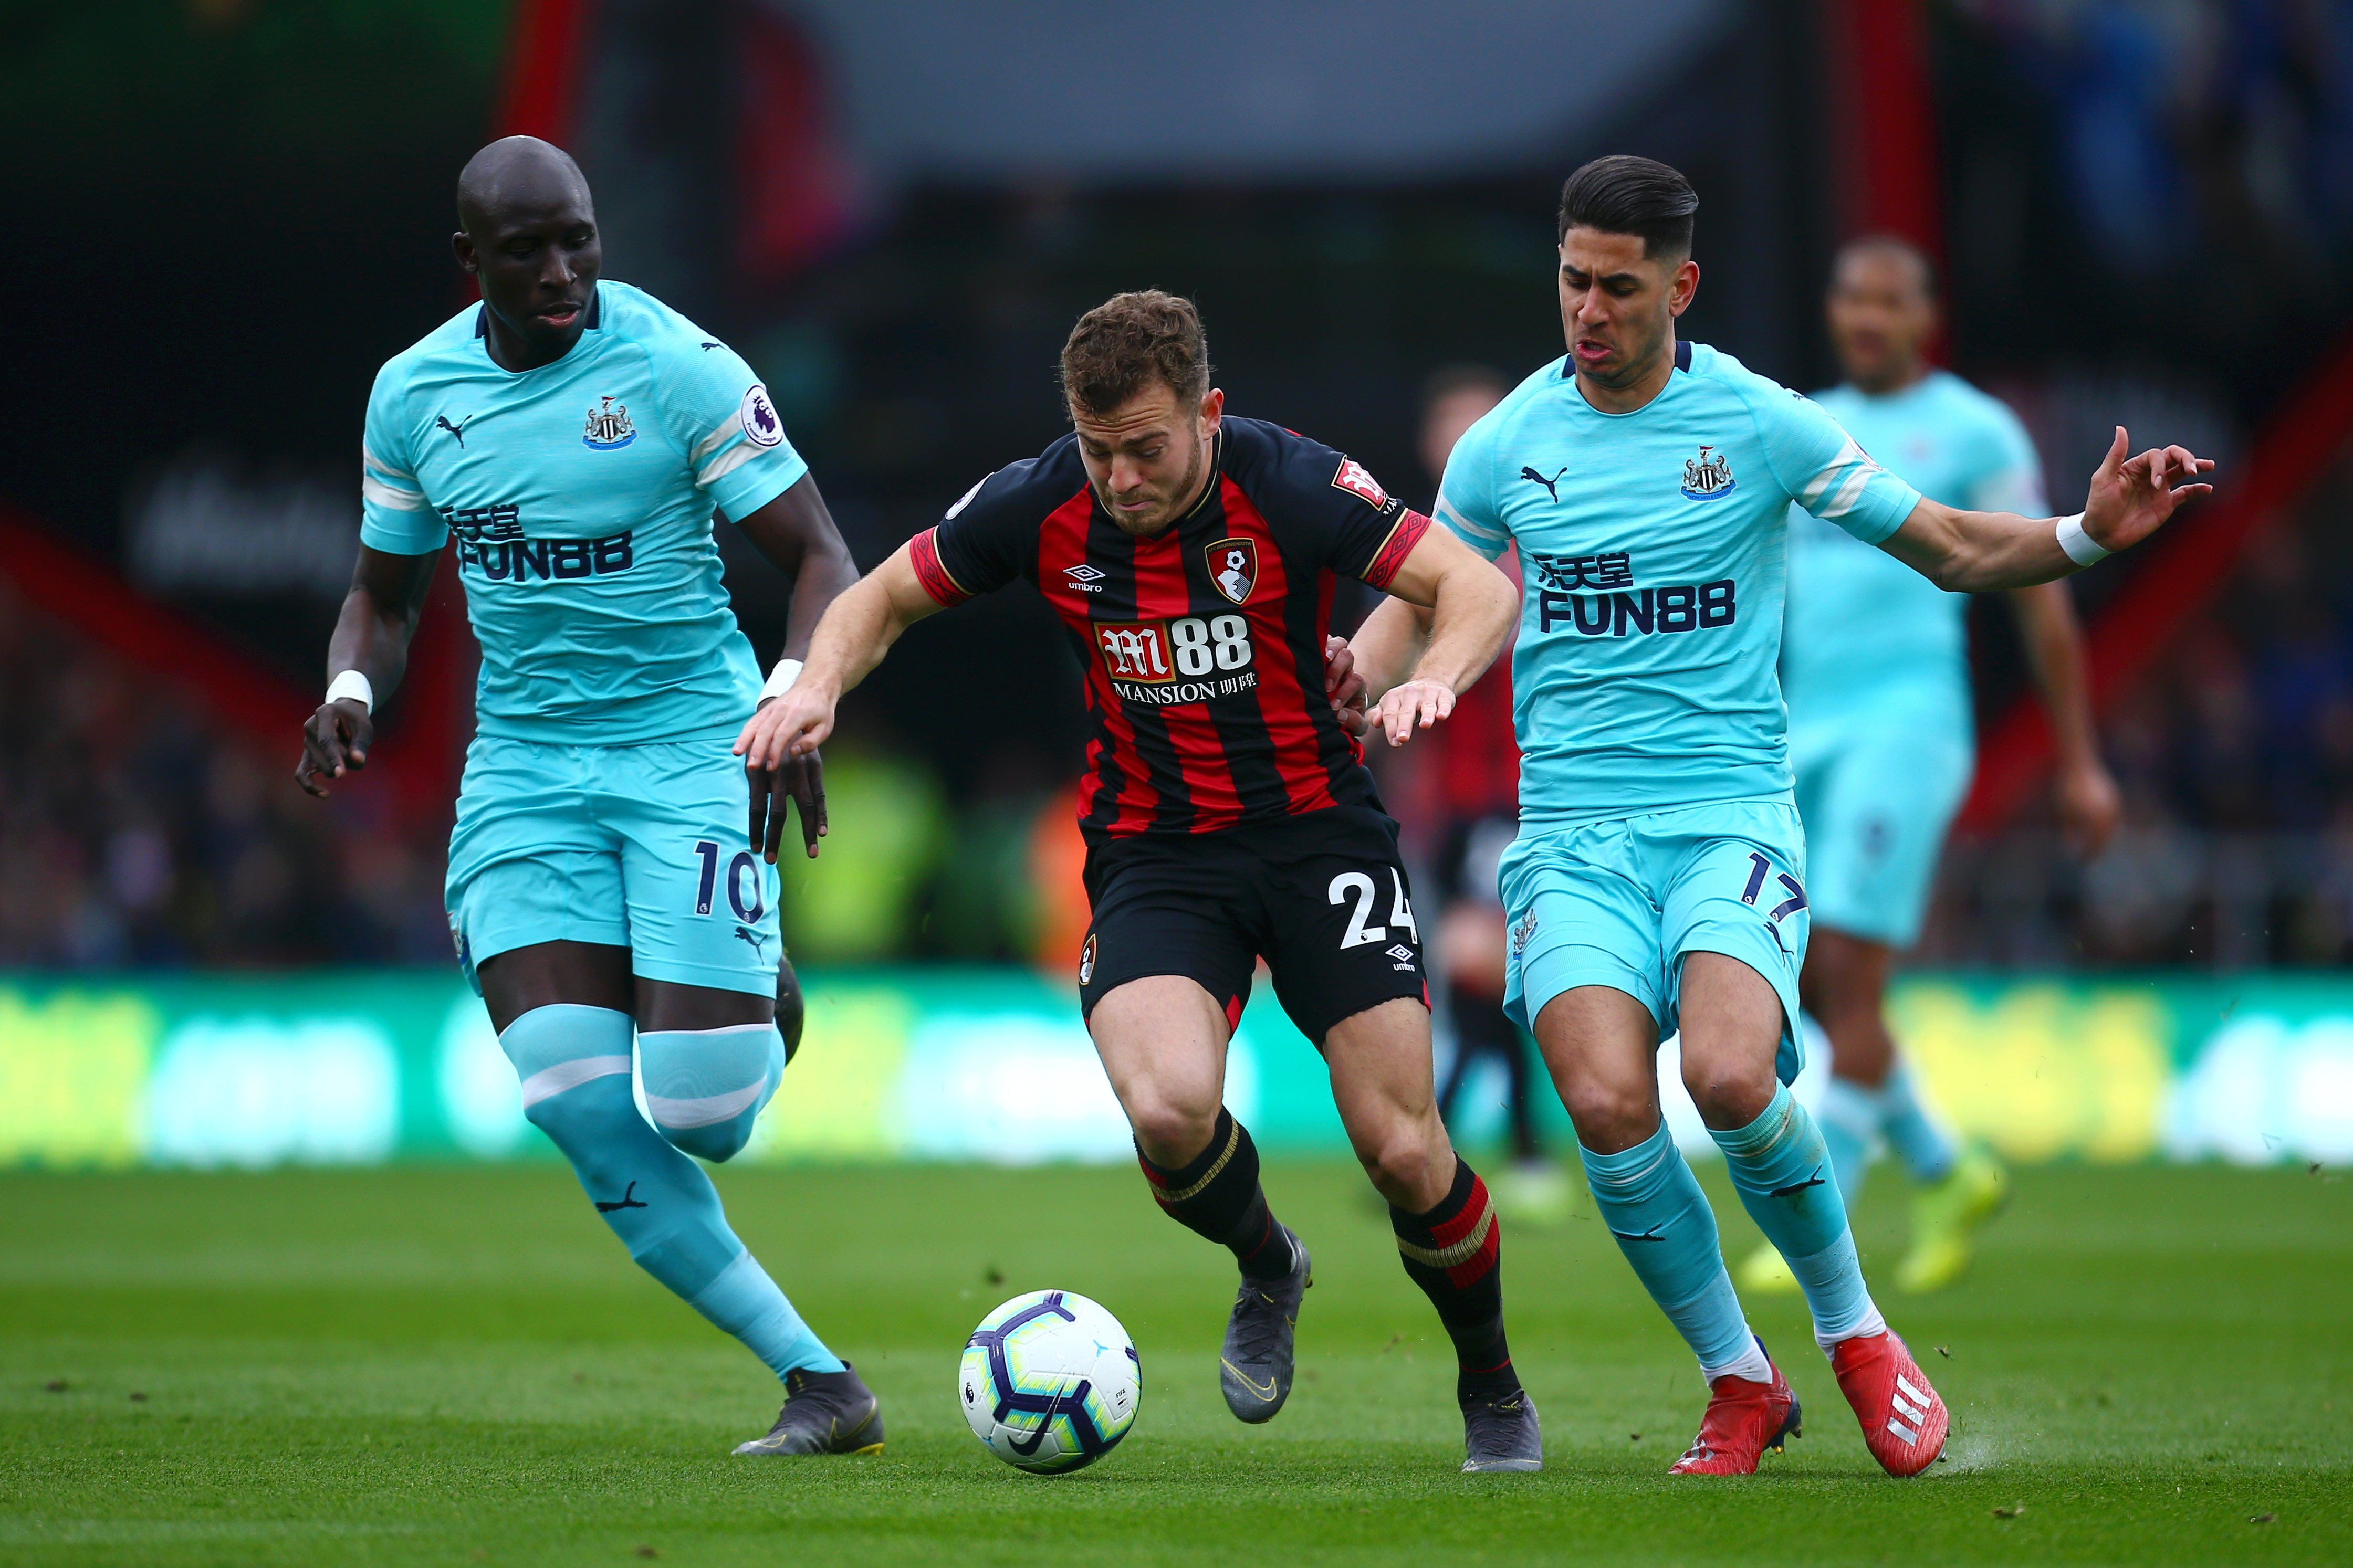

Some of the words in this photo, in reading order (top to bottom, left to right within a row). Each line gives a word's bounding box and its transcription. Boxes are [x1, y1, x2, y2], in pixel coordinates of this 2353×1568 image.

[1714, 489, 1731, 498] UNITED
[461, 529, 633, 582] FUN88
[1068, 582, 1102, 592] umbro
[1540, 579, 1735, 637] FUN88
[1113, 681, 1216, 704] MANSION
[693, 840, 765, 925] 10
[1739, 850, 1810, 924] 17
[1328, 867, 1418, 950] 24
[1393, 962, 1415, 972] umbro
[1116, 1388, 1125, 1398] FIFA
